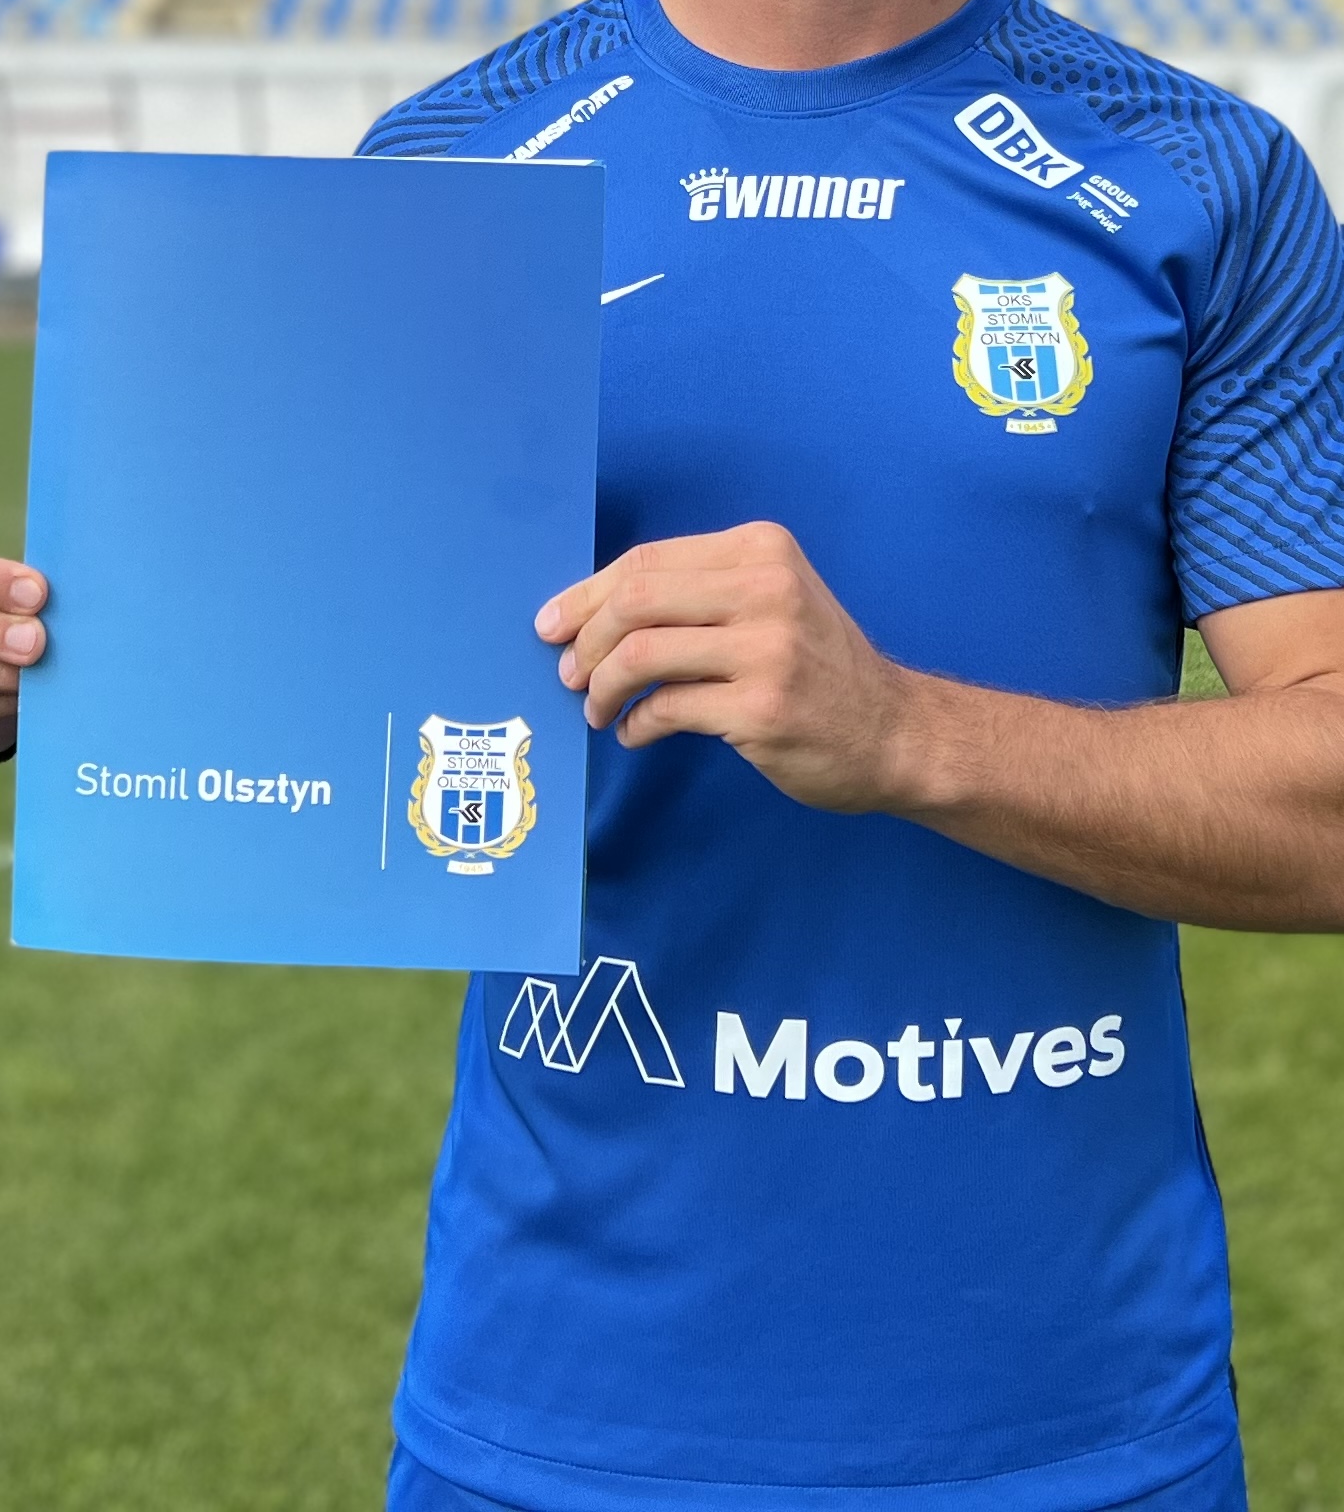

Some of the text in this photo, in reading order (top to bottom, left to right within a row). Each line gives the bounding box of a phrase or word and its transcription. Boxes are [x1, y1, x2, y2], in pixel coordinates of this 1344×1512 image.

[967, 101, 1071, 181] DBK
[1088, 174, 1139, 208] GROUP
[997, 294, 1032, 307] OKS
[987, 312, 1048, 326] STOMIL
[980, 331, 1061, 346] OLSZTYN
[1017, 422, 1046, 432] 1945
[459, 738, 492, 751] OKS
[447, 757, 501, 770] STOMIL
[75, 763, 331, 813] Stomil Olsztyn
[437, 775, 511, 790] OLSZTYN
[459, 863, 484, 873] 1945
[714, 1010, 1126, 1103] Motives
